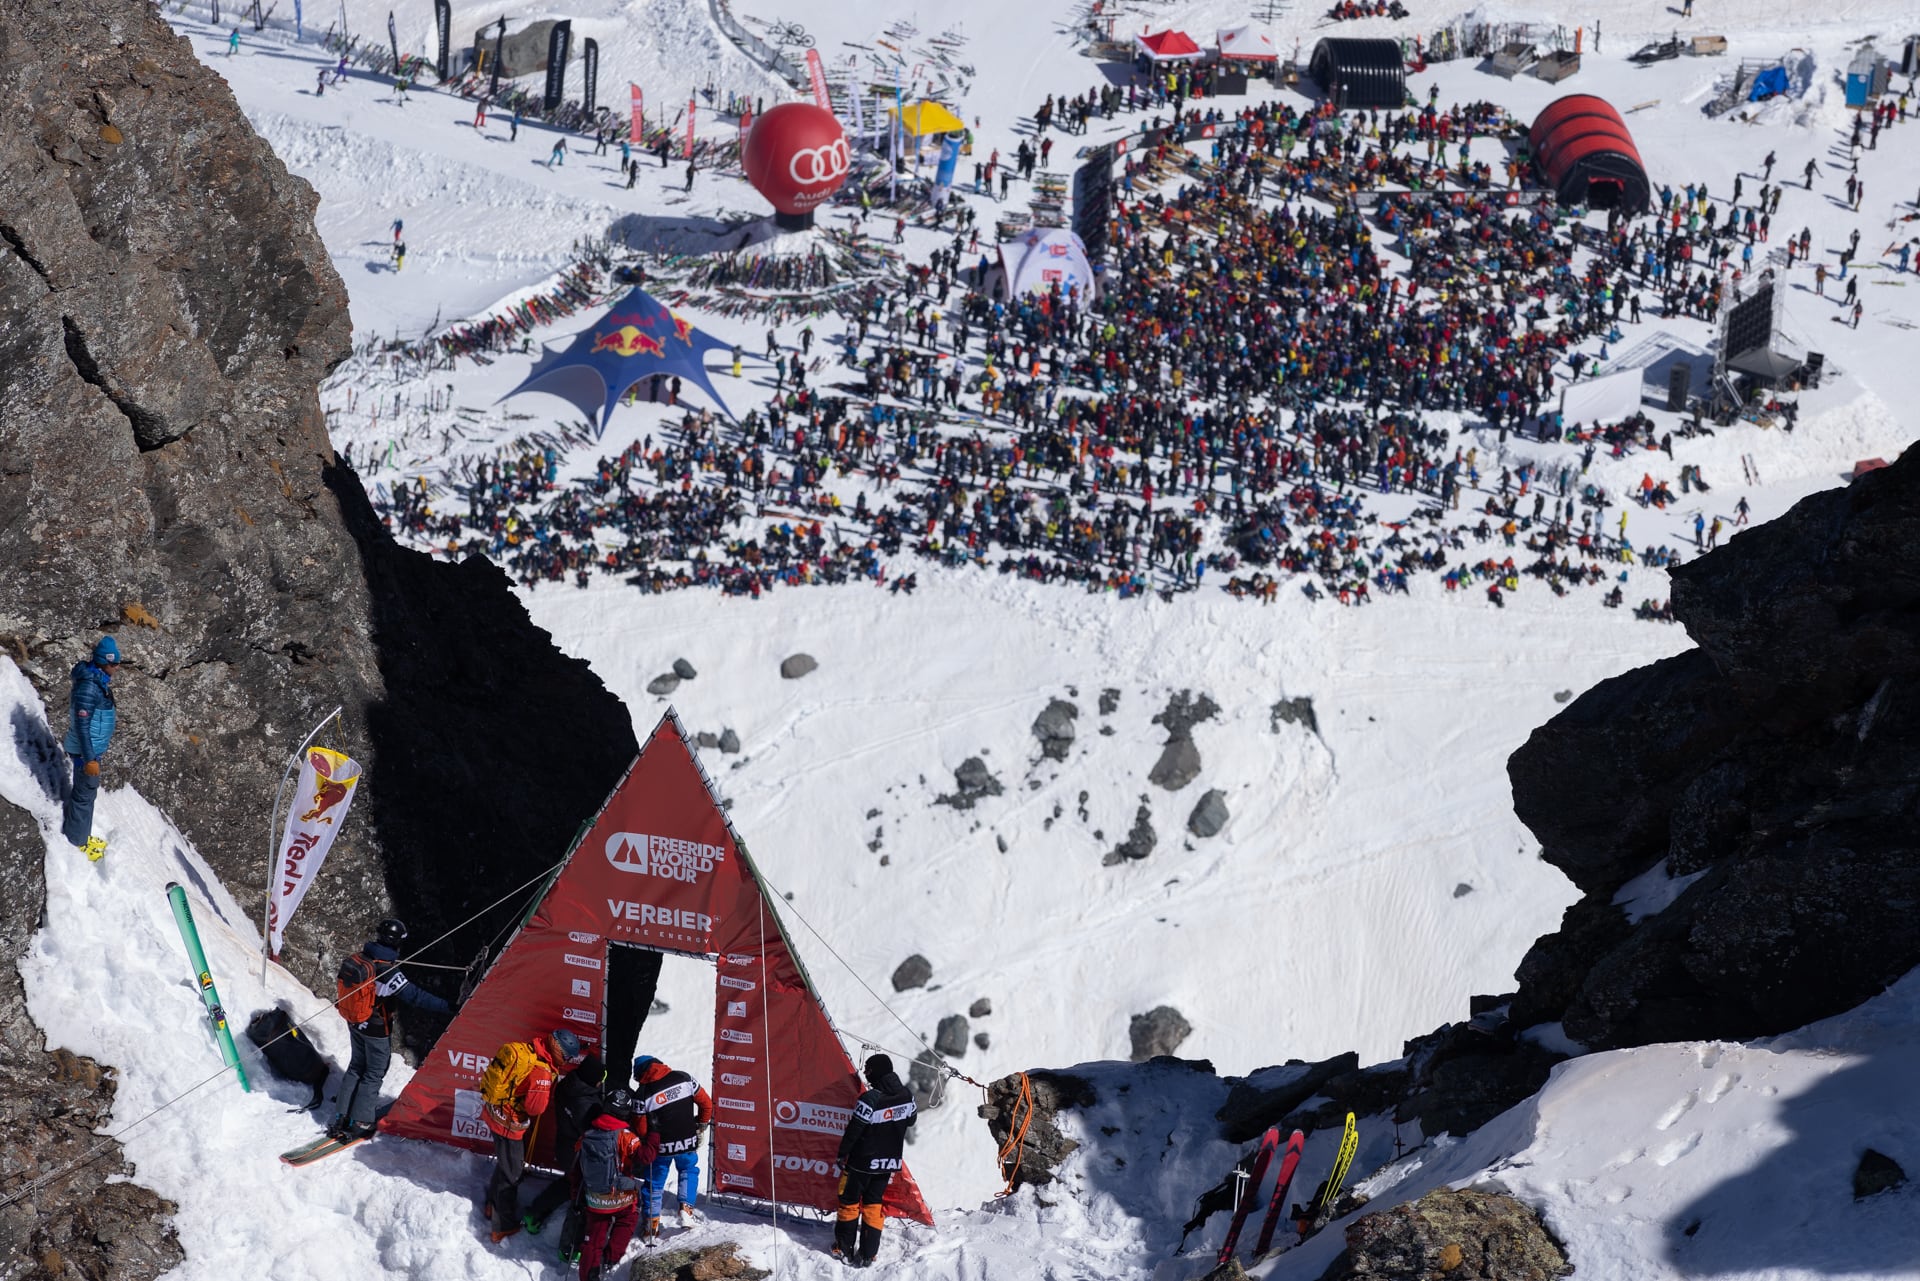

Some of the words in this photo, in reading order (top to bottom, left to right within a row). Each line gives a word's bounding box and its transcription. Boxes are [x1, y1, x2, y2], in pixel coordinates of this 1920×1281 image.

[794, 187, 831, 200] Audi
[650, 835, 725, 861] FREERIDE
[650, 849, 714, 873] WORLD
[650, 862, 697, 884] TOUR
[607, 898, 713, 932] VERBIER
[616, 925, 649, 936] PURE
[660, 932, 710, 944] ENERGY
[448, 1050, 493, 1074] VER
[812, 1109, 853, 1121] LOTERI
[456, 1120, 492, 1138] Vala
[772, 1154, 830, 1176] TOYO
